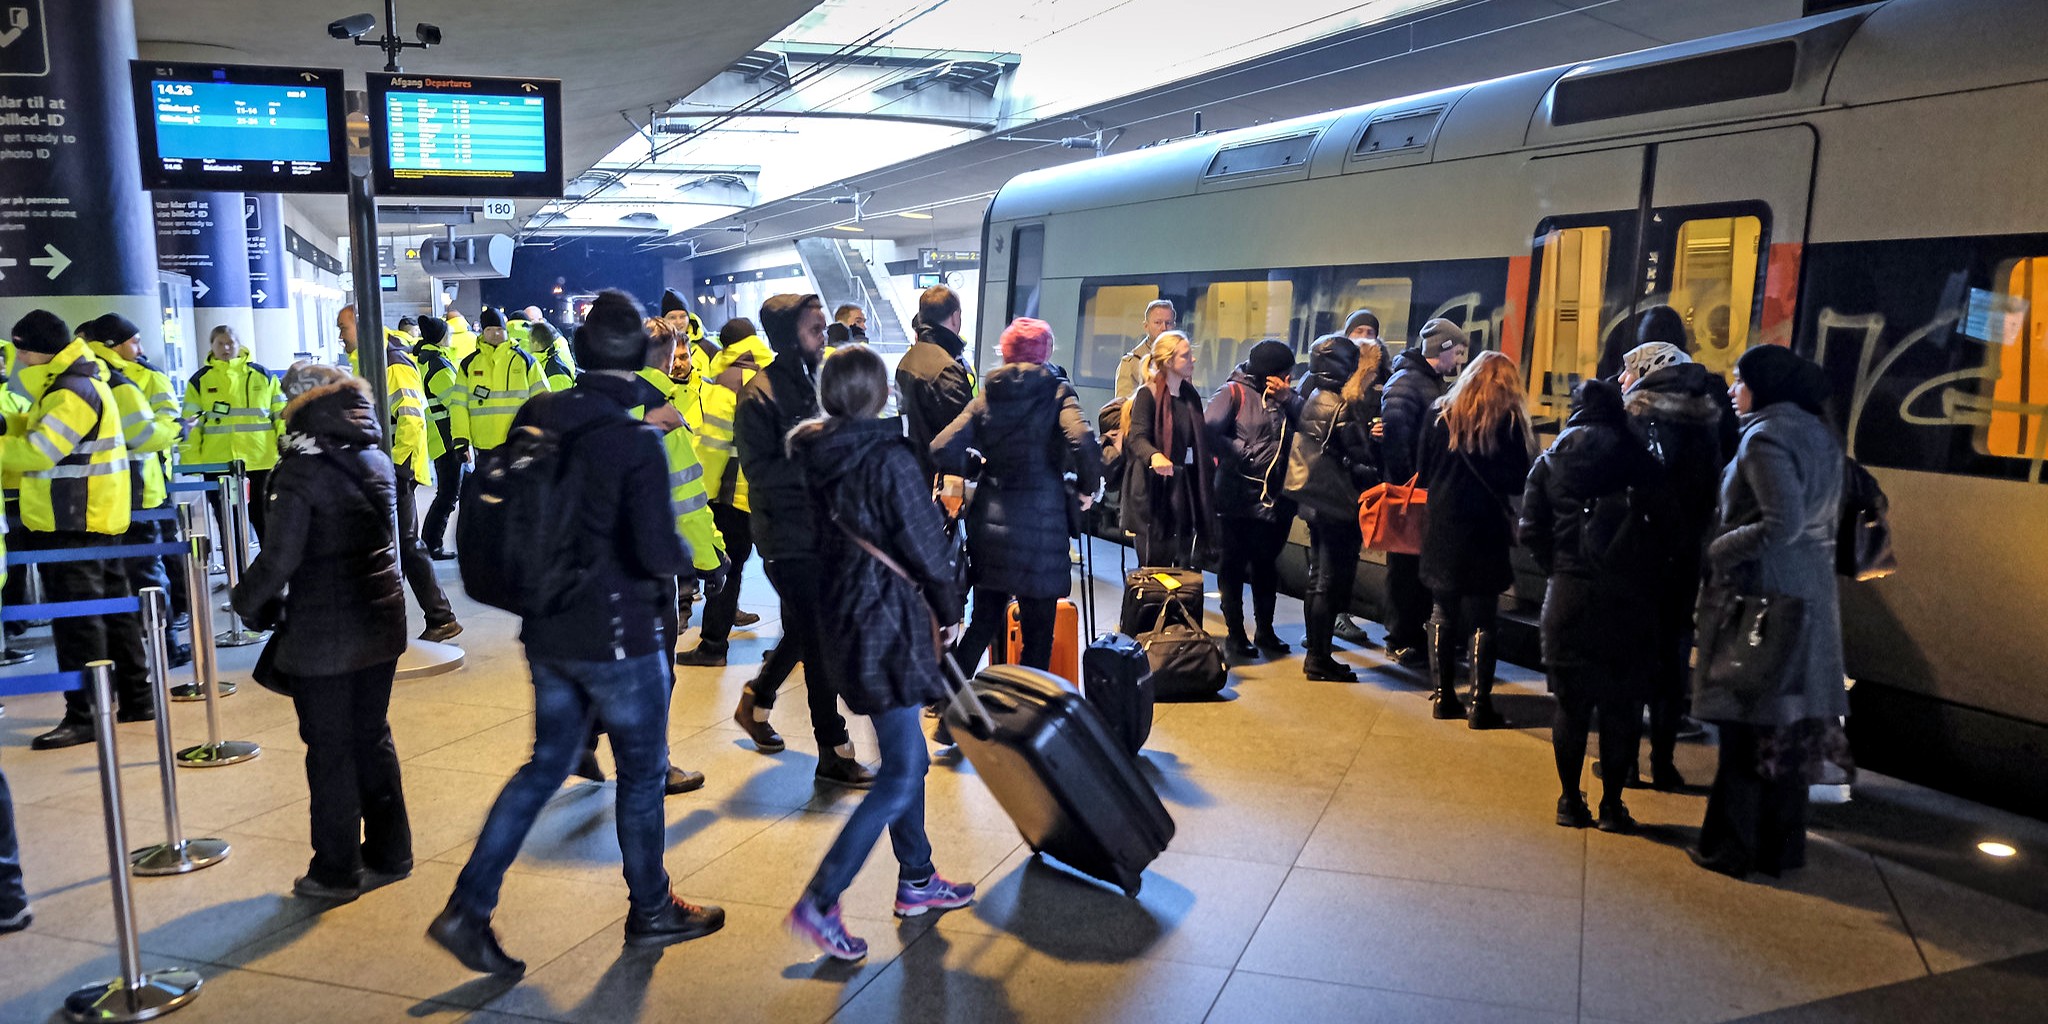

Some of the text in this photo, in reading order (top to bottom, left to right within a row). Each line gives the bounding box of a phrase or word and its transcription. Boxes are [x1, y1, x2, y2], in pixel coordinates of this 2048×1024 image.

[390, 77, 472, 89] Afgang Departures
[27, 96, 44, 108] til
[49, 98, 66, 110] at
[24, 132, 58, 145] ready
[62, 135, 76, 143] to
[36, 148, 50, 159] ID
[487, 204, 511, 215] 180
